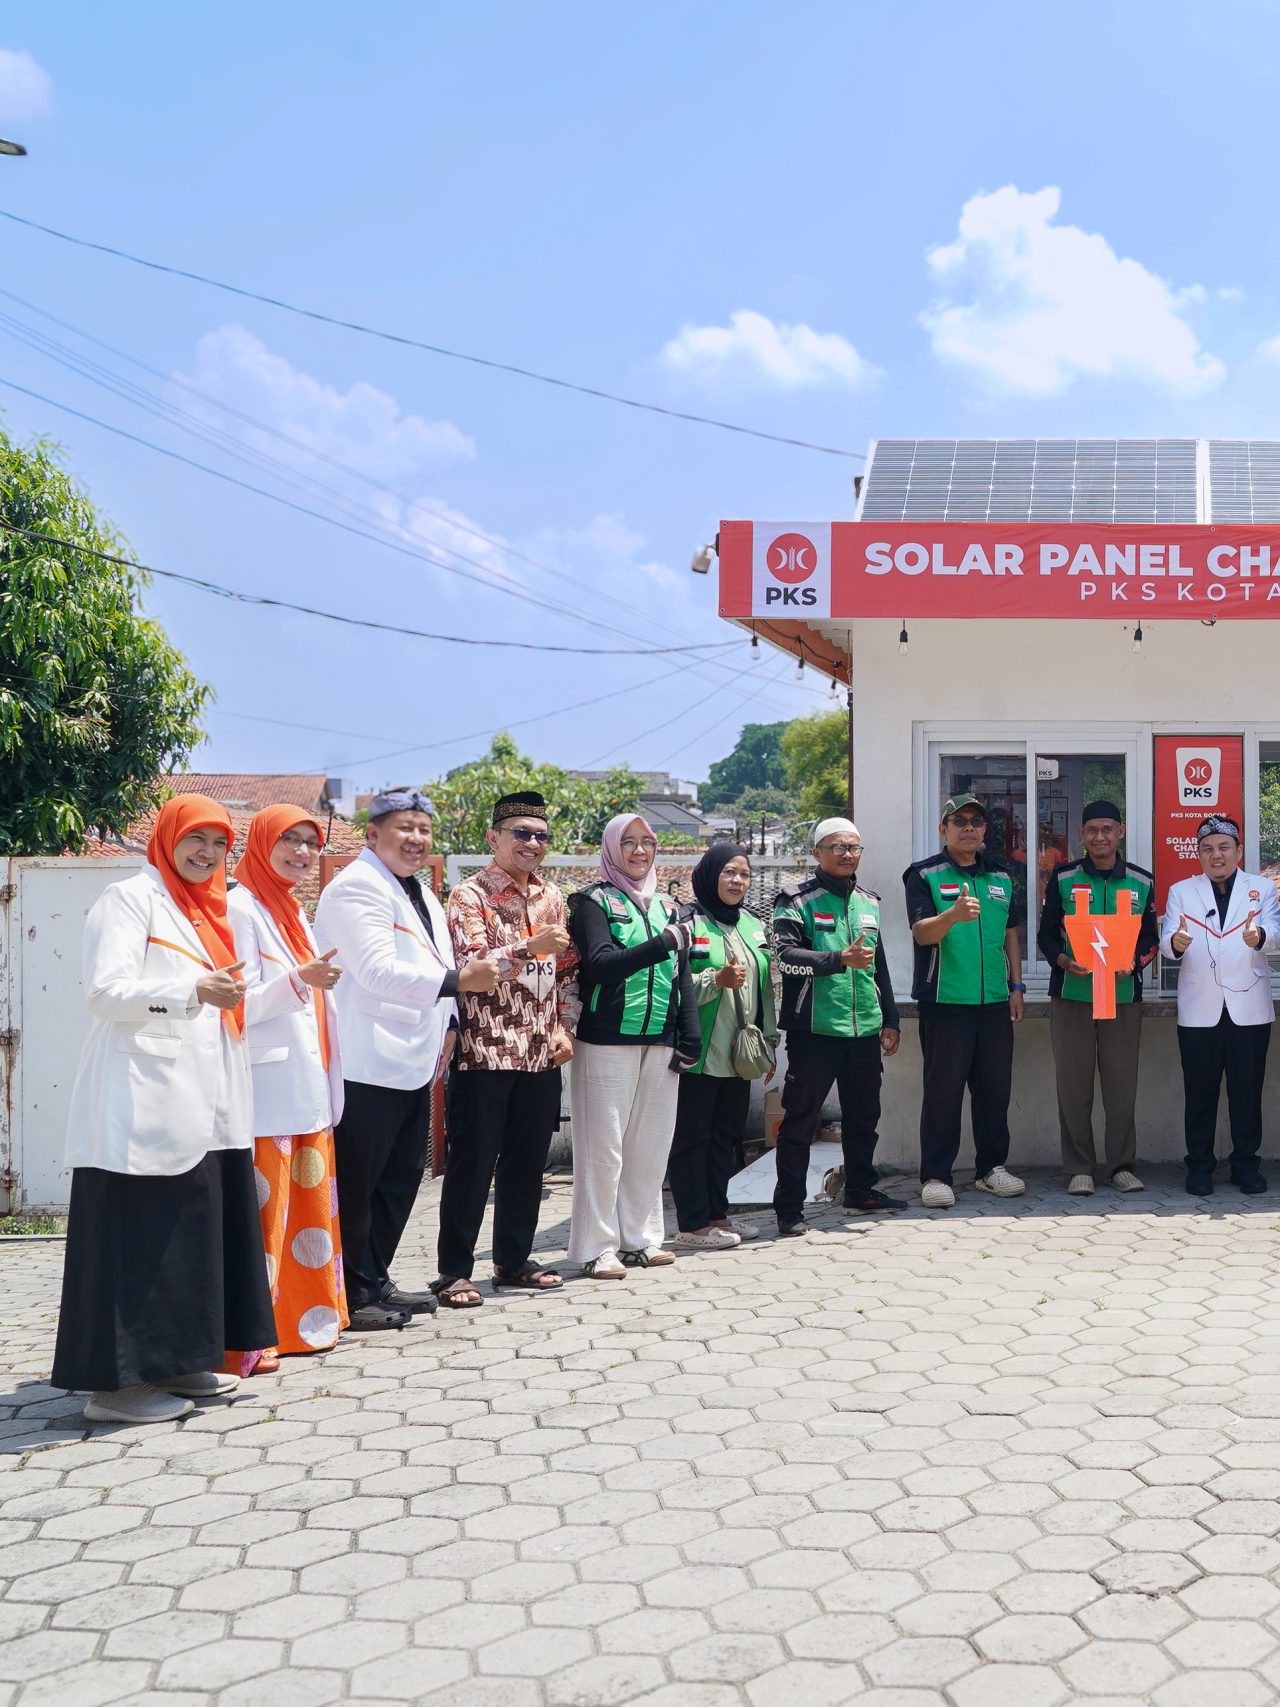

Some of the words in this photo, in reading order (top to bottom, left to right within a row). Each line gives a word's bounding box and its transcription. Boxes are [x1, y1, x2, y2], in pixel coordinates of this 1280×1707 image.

[865, 542, 1024, 576] SOLAR
[1040, 543, 1194, 577] PANEL
[765, 587, 817, 606] PKS
[1080, 582, 1157, 601] PKS
[1184, 787, 1212, 798] PKS
[526, 962, 553, 976] PKS
[779, 961, 814, 976] BOGOR
